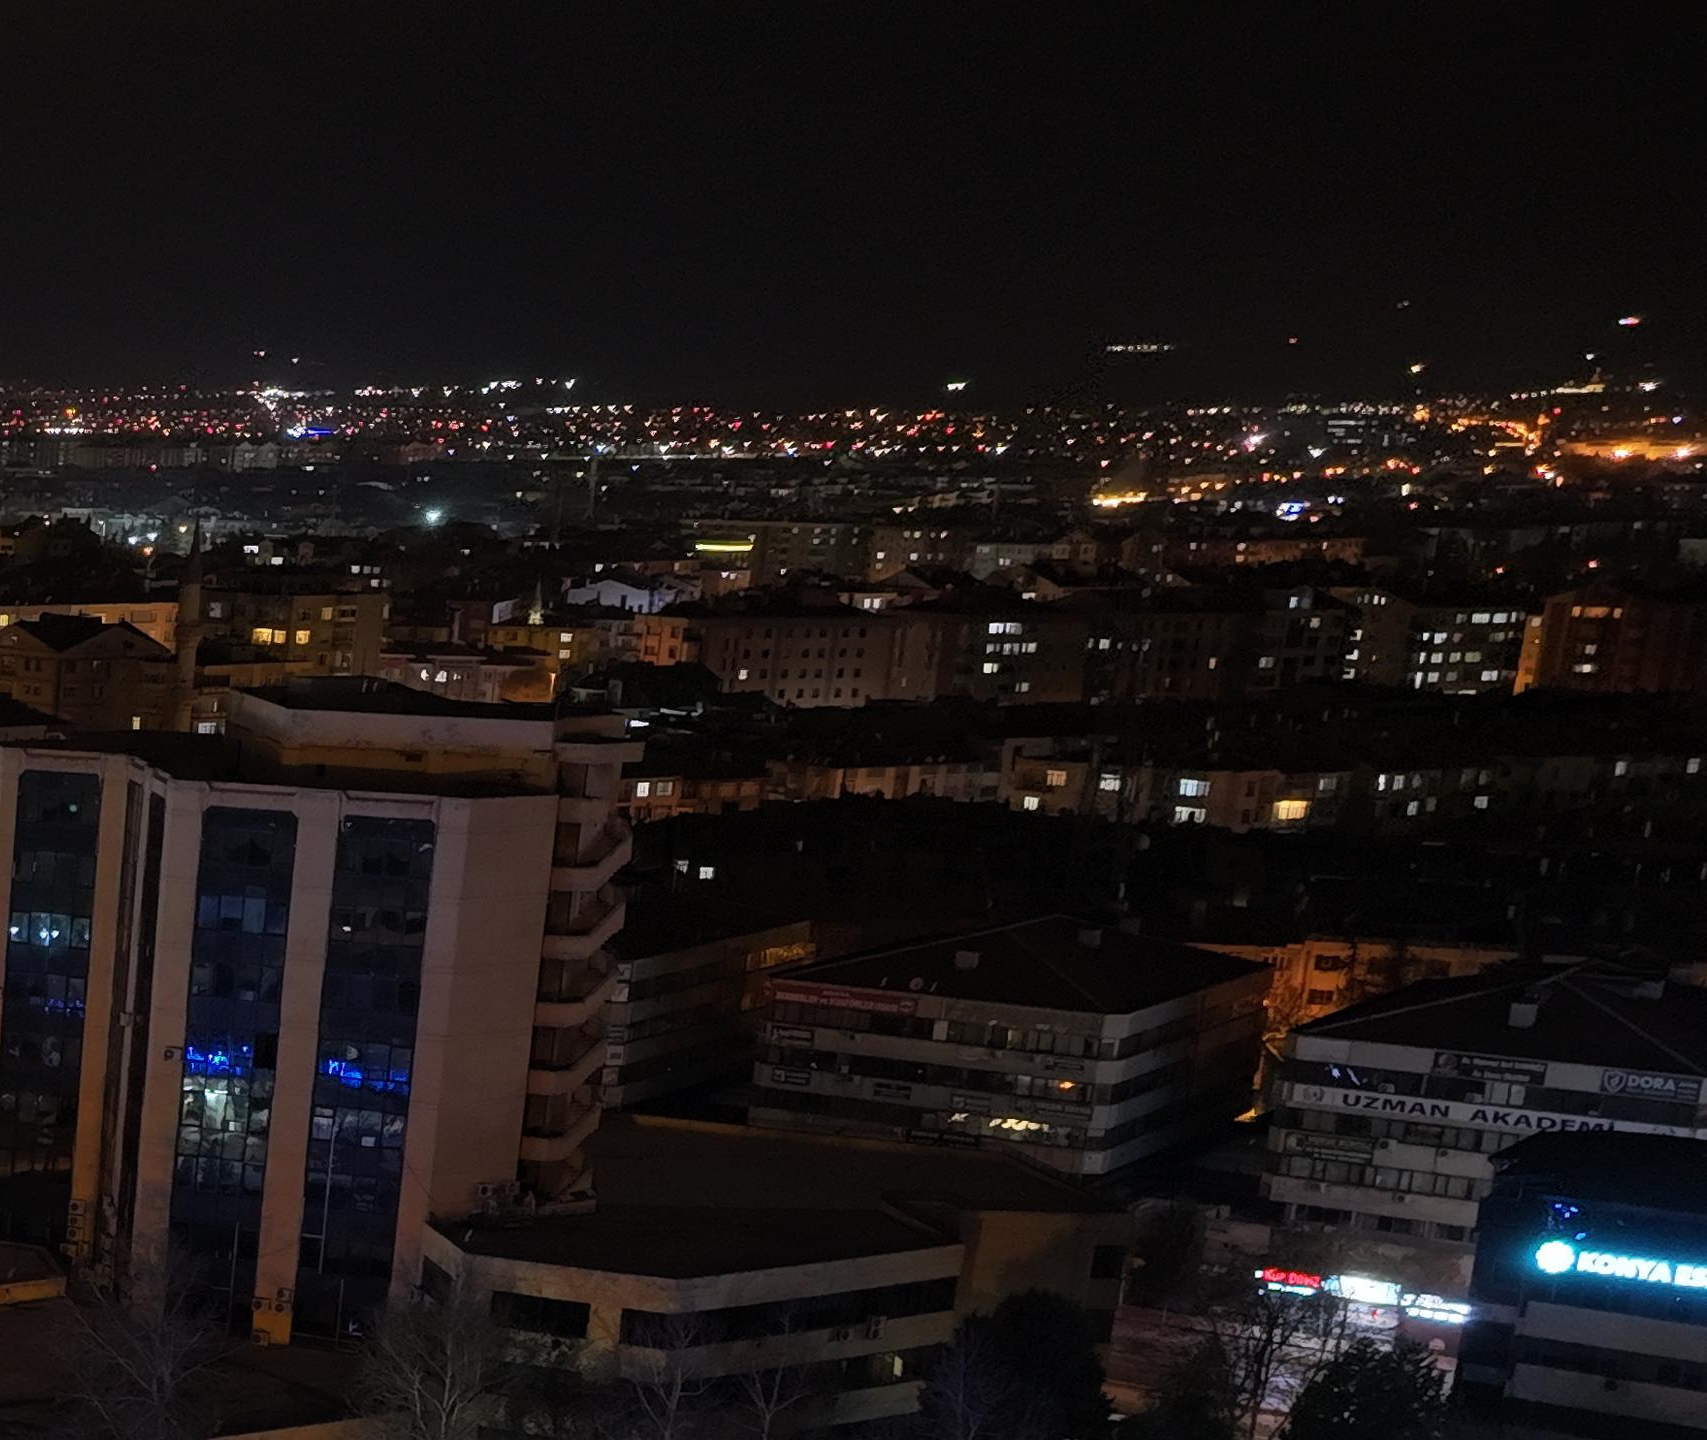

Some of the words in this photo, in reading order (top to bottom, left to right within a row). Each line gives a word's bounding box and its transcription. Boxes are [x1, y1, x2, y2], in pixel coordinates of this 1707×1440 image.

[1626, 1073, 1677, 1092] DORA
[1342, 1093, 1451, 1119] UZMAN
[1576, 1250, 1673, 1284] KONYA
